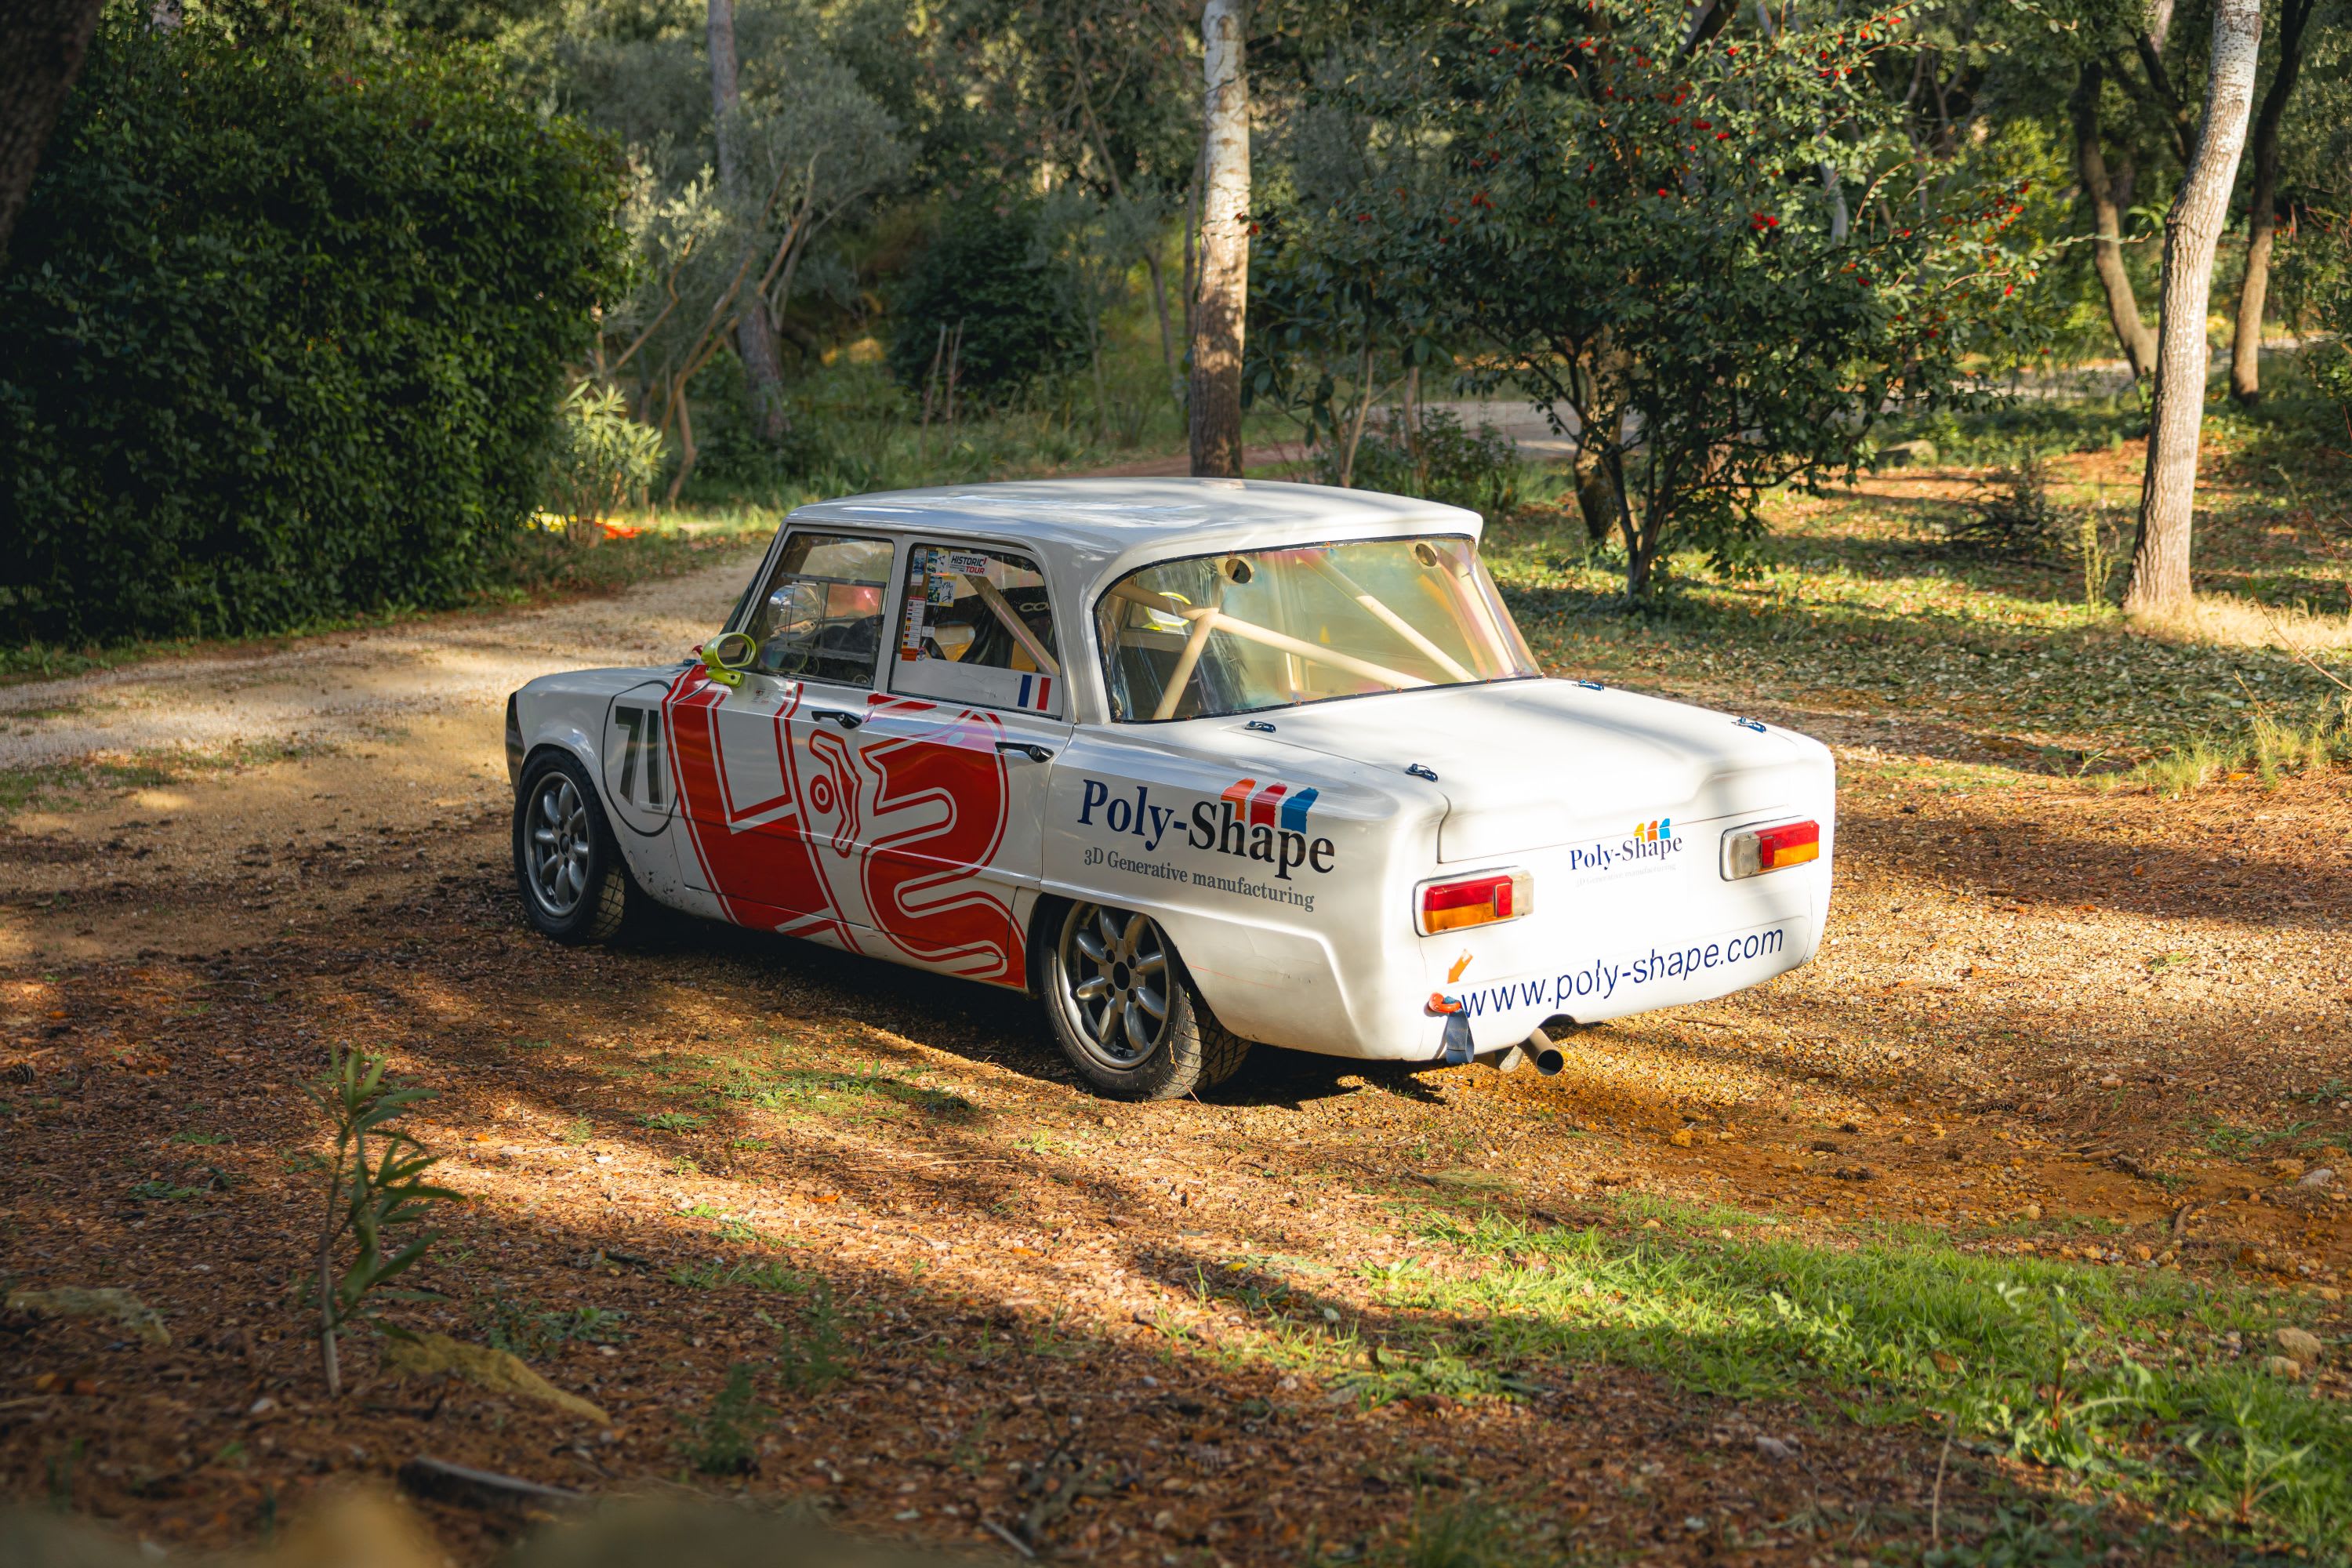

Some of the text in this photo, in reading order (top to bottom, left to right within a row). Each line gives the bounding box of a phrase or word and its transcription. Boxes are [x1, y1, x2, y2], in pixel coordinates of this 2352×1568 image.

[950, 555, 983, 567] HISTORIC
[965, 565, 985, 575] TOUR
[1018, 601, 1051, 612] CO
[615, 705, 661, 809] 71
[1076, 779, 1335, 881] Poly-Shape
[1569, 837, 1683, 871] Poly-Shape
[1624, 863, 1677, 878] manufacturing
[1083, 847, 1315, 913] 3D Generative manufacturing
[1461, 927, 1784, 1018] www.poly-shape.com
